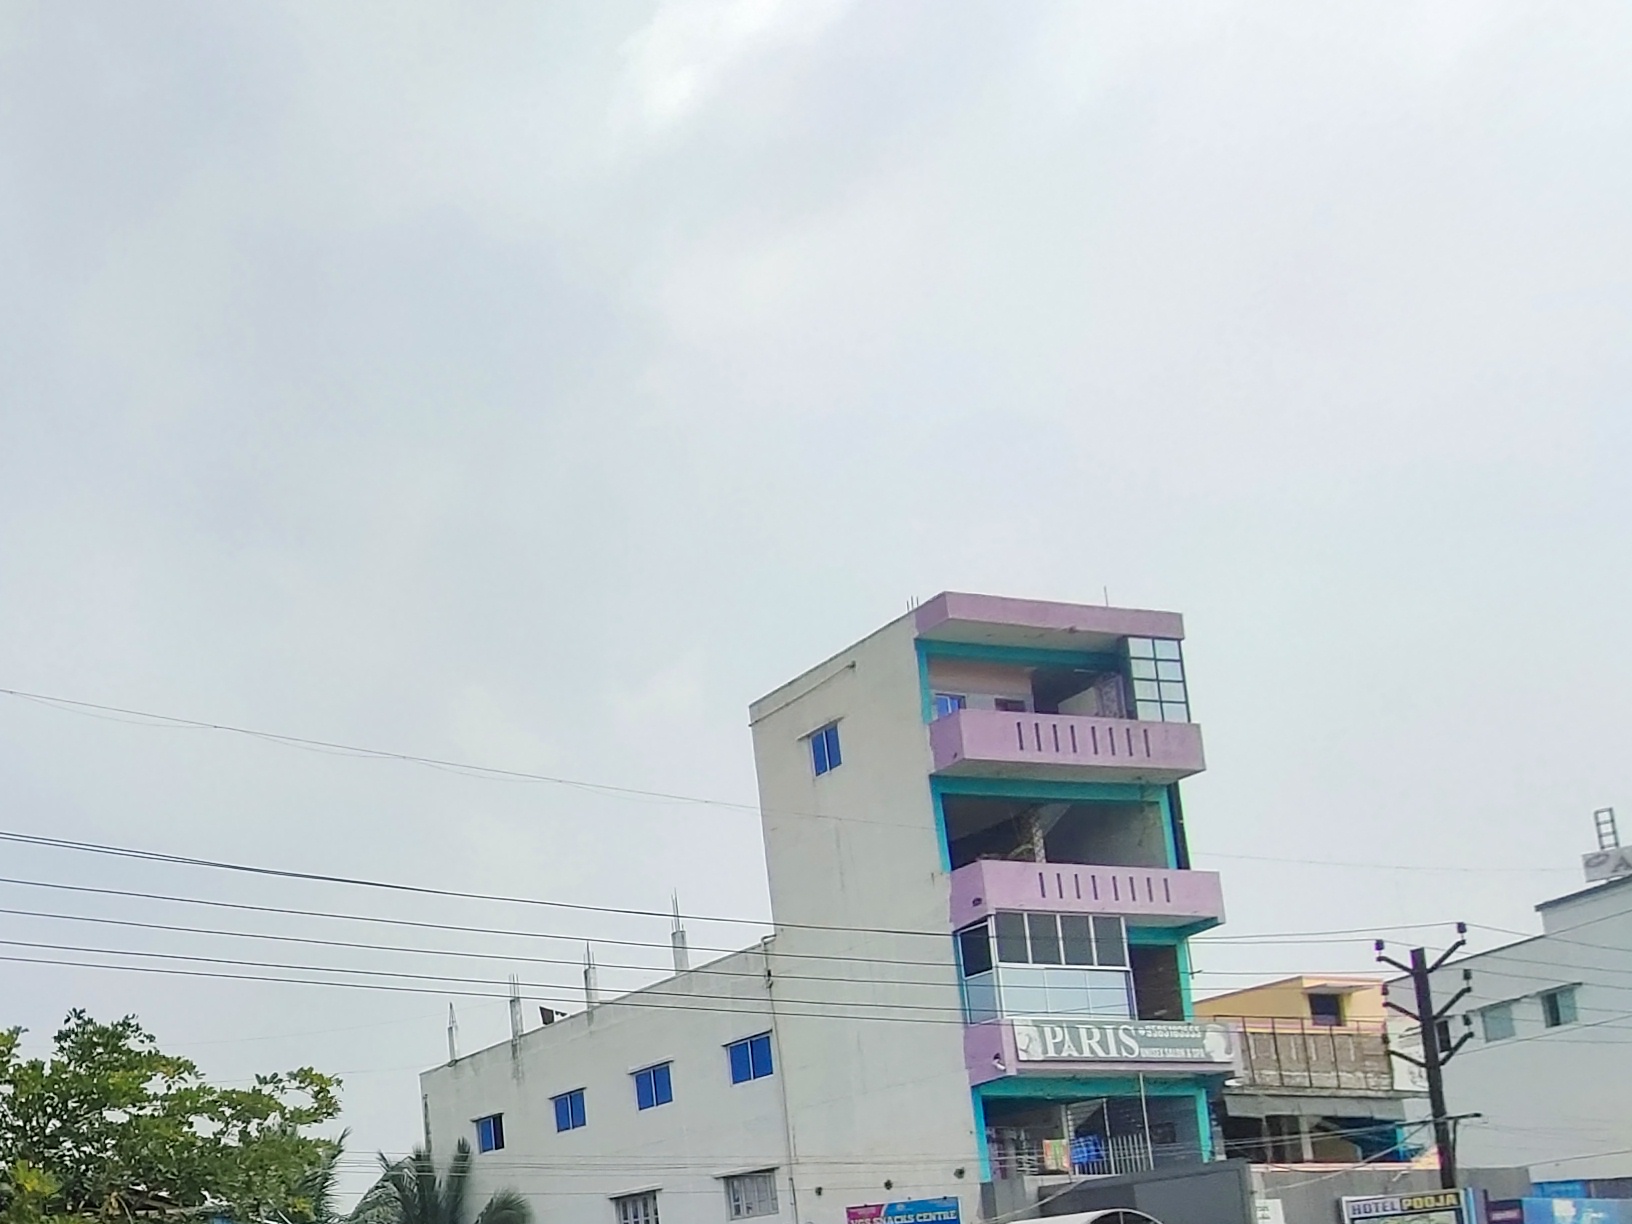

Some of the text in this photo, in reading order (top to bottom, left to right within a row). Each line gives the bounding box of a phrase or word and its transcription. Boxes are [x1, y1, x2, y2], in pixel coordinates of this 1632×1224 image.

[1041, 1023, 1140, 1058] PARIS
[1351, 1194, 1459, 1216] HOTEL POOJA
